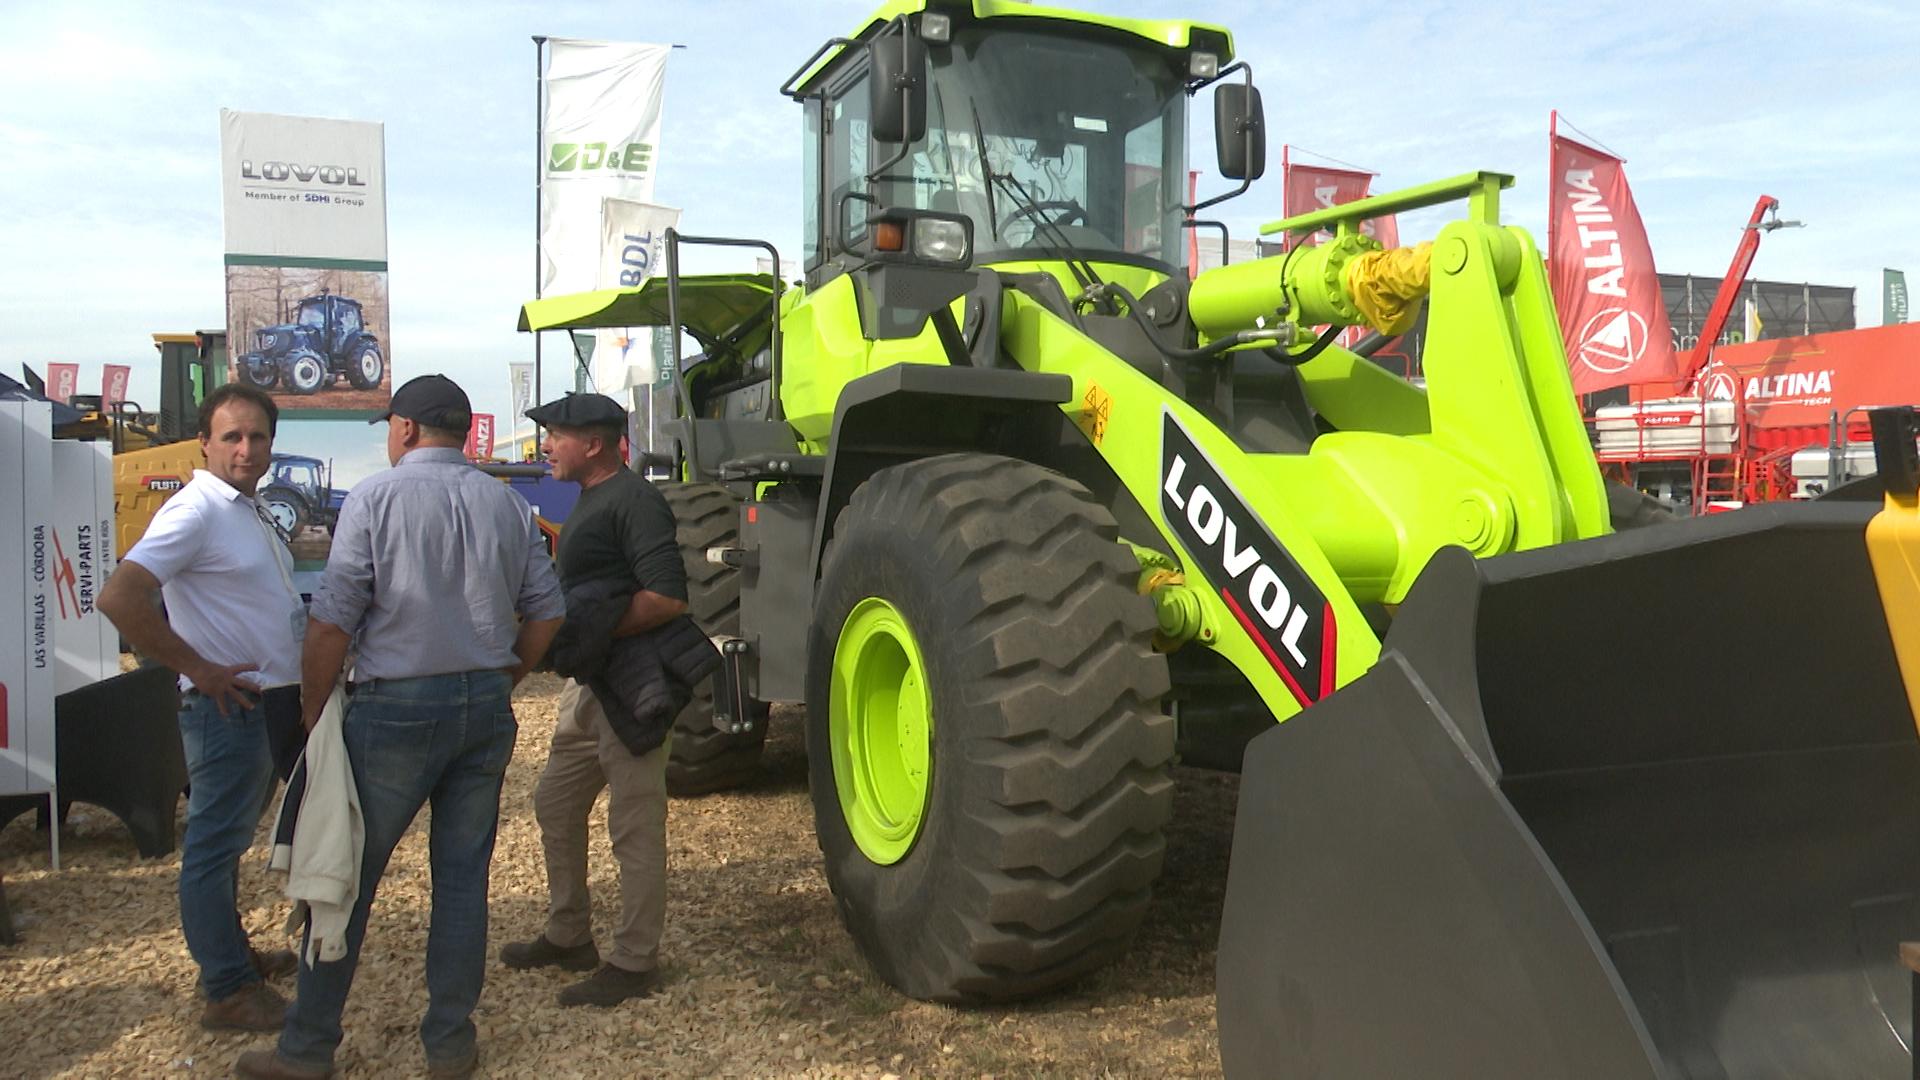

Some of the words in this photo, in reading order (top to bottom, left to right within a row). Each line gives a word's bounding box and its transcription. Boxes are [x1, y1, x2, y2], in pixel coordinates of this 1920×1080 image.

[241, 159, 366, 186] LOVOL
[245, 191, 287, 200] Member
[289, 193, 300, 202] of
[334, 196, 365, 208] Group
[1564, 168, 1628, 298] ALTINA
[619, 231, 652, 287] BDL
[1744, 370, 1832, 400] ALTINA
[1803, 397, 1832, 406] TECH
[77, 525, 94, 614] SERVI-PARTS
[1164, 453, 1309, 669] LOVOL
[35, 649, 46, 668] LAS
